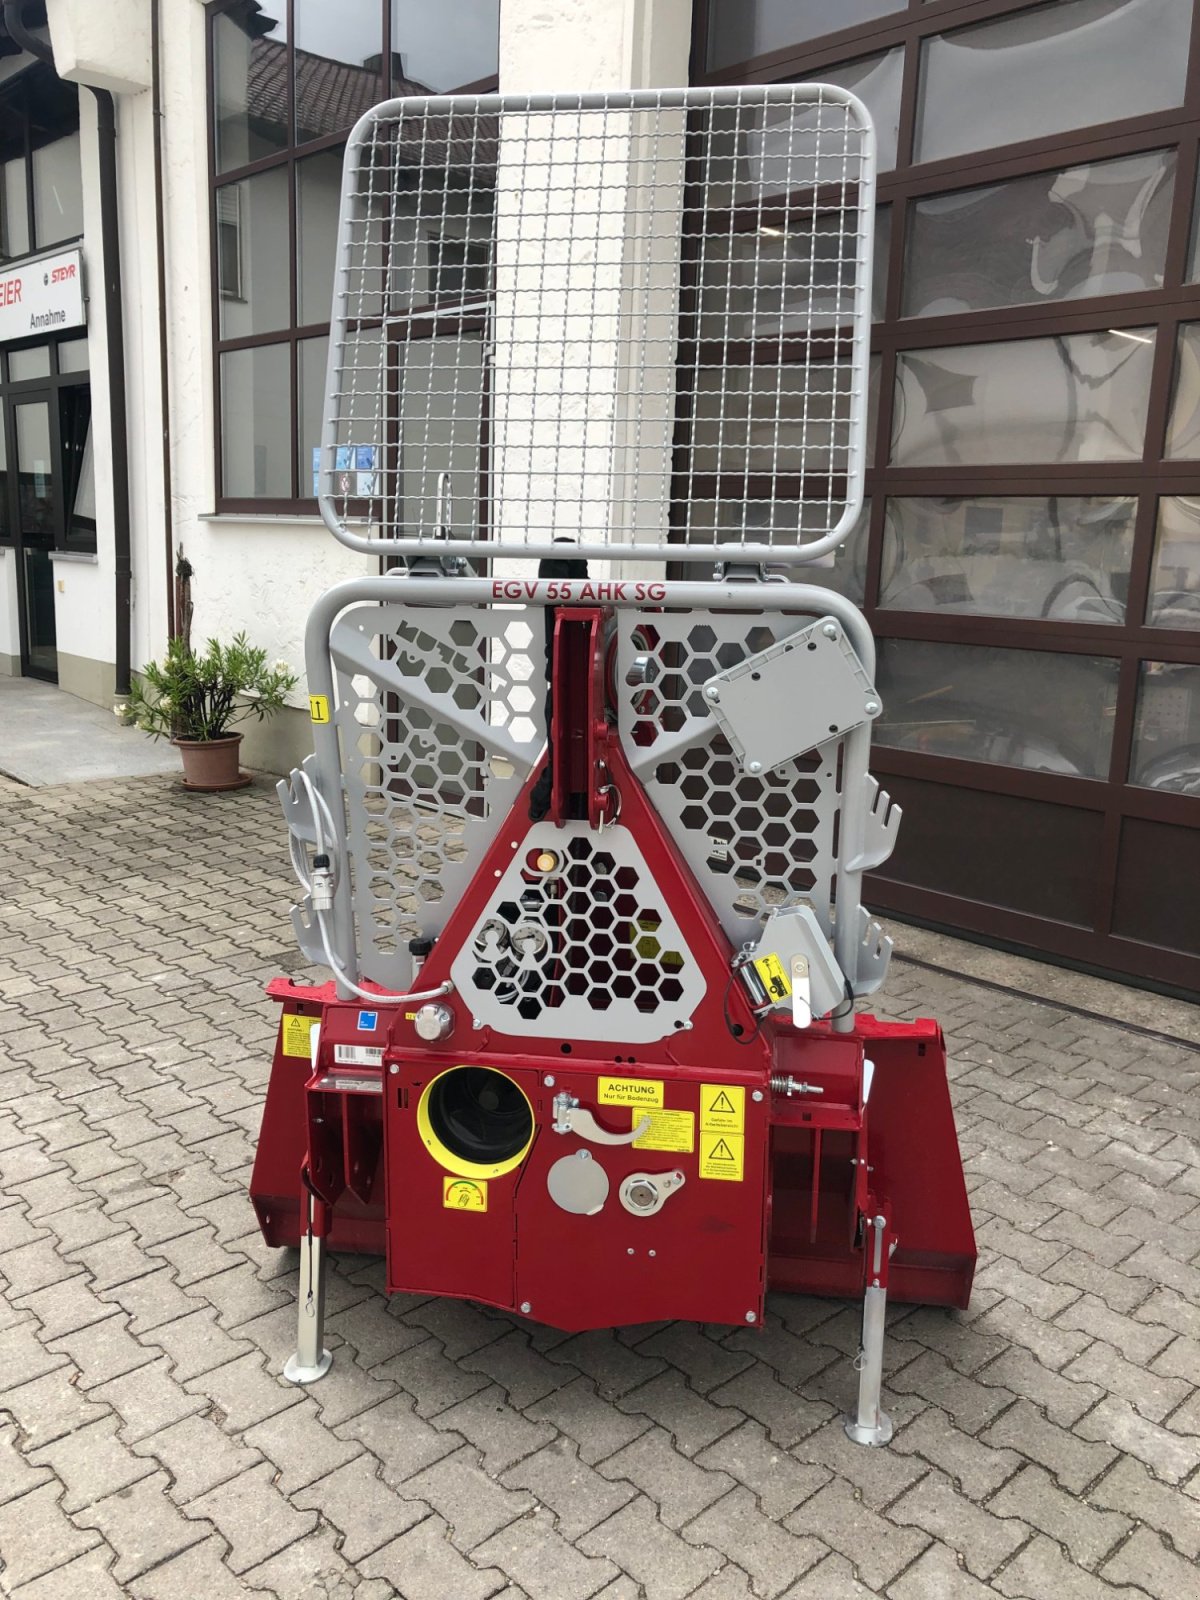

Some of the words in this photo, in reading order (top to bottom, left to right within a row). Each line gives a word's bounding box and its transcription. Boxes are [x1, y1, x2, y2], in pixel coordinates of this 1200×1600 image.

[51, 264, 76, 284] STEYR
[30, 309, 66, 329] Annahme
[492, 581, 539, 599] EGV
[546, 582, 572, 600] 55
[579, 583, 627, 601] AHK
[635, 583, 666, 601] SG
[608, 1083, 655, 1094] ACHTUNG
[627, 1095, 659, 1103] Bodenzug
